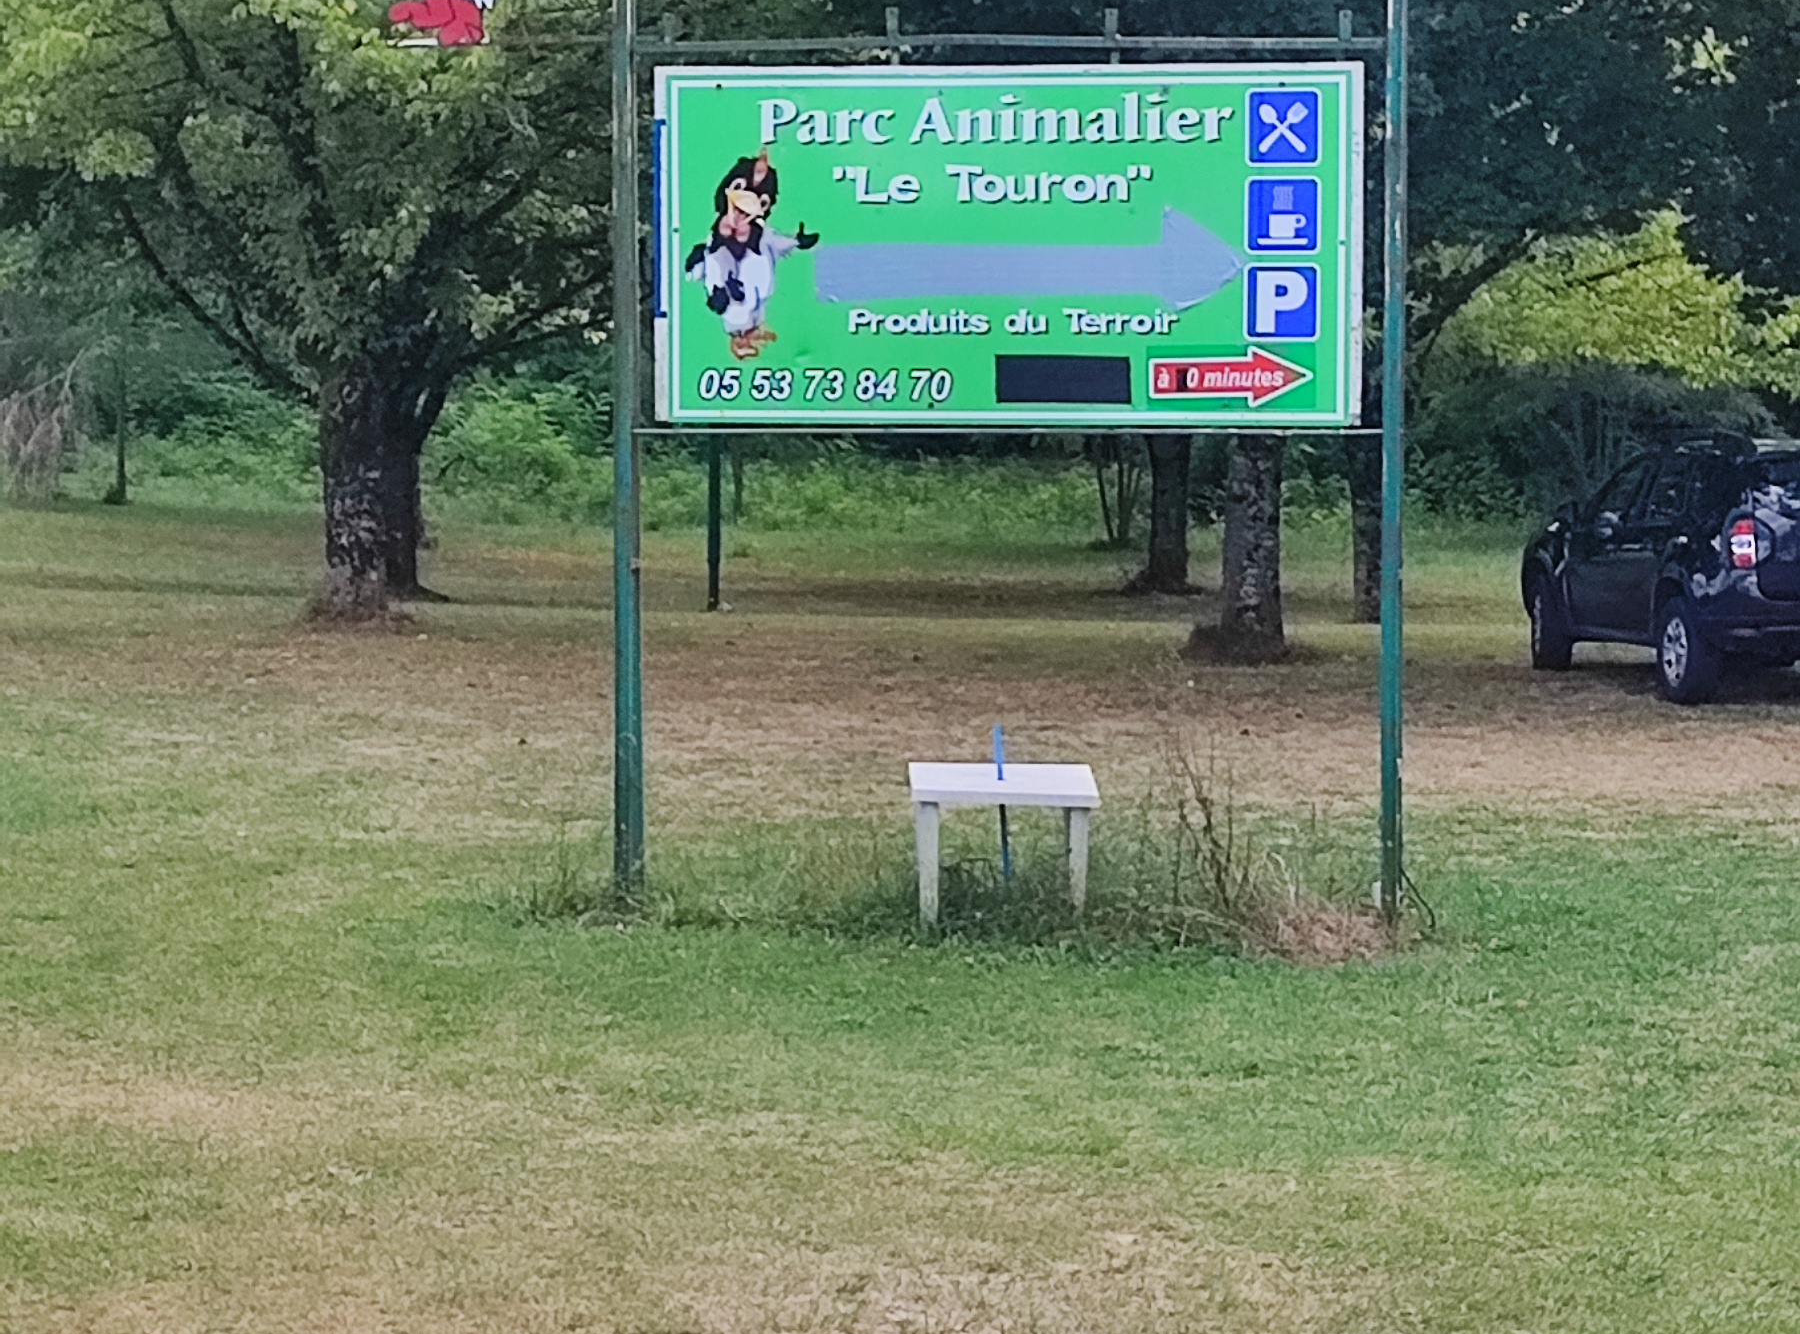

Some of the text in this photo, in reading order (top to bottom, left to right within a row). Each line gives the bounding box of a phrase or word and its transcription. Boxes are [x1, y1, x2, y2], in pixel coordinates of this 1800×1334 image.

[758, 92, 1234, 145] Parc Animalier
[832, 165, 1152, 204] "Le Touron"
[1254, 271, 1309, 333] P
[848, 308, 1179, 334] Produits du Terroir
[700, 369, 951, 402] 05 53 73 84 70
[1157, 368, 1170, 387] à
[1203, 367, 1284, 388] minutes
